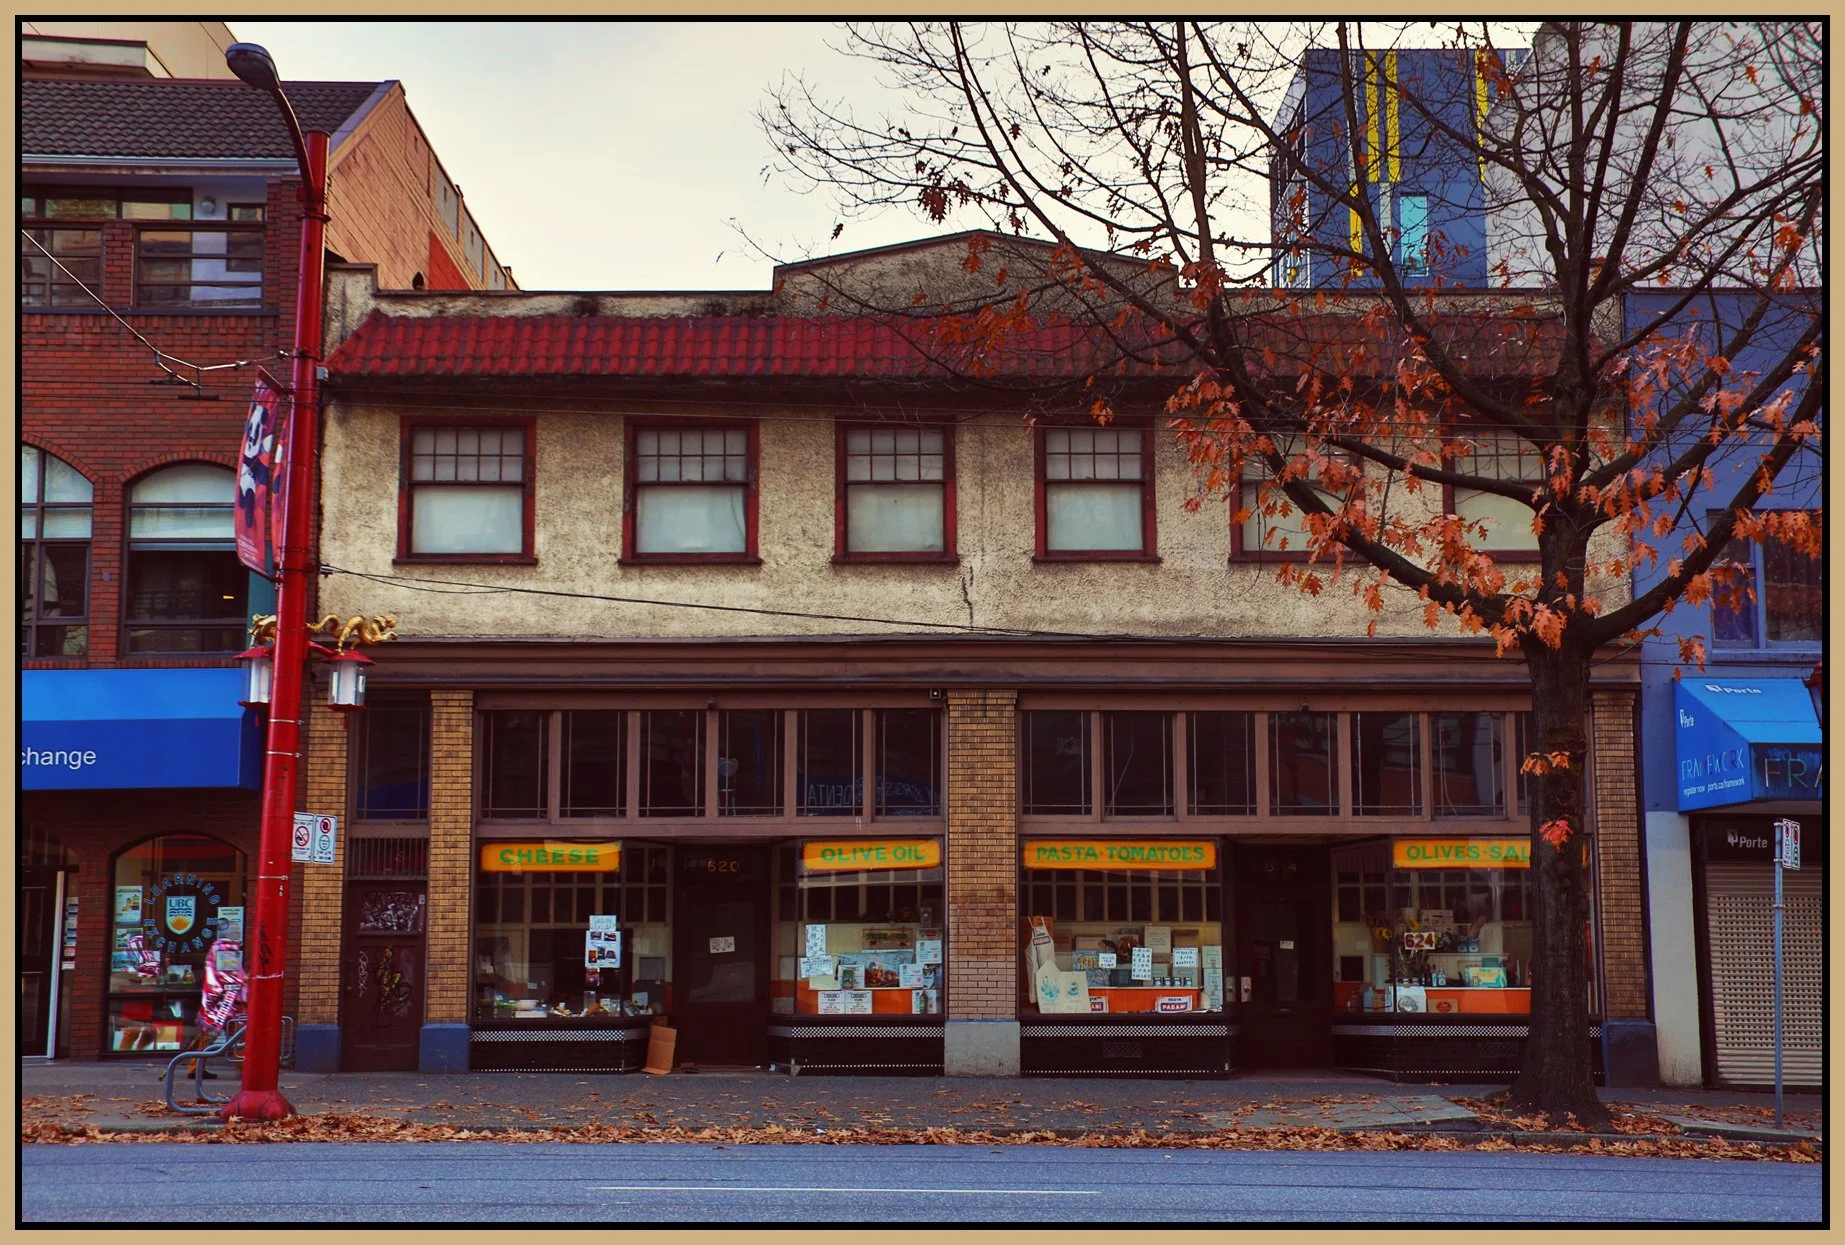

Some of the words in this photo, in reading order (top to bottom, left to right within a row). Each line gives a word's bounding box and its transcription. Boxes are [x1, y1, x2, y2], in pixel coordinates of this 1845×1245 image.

[1739, 836, 1768, 848] Porte
[499, 849, 600, 865] CHEESE
[821, 846, 887, 861] OLIVE
[892, 846, 926, 860] OIL
[1036, 846, 1099, 861] PASTA
[1107, 846, 1205, 861] TOMATOES
[1406, 845, 1481, 860] OLIVES
[707, 860, 740, 873] 620
[168, 898, 194, 908] UBC
[1405, 933, 1435, 949] 624
